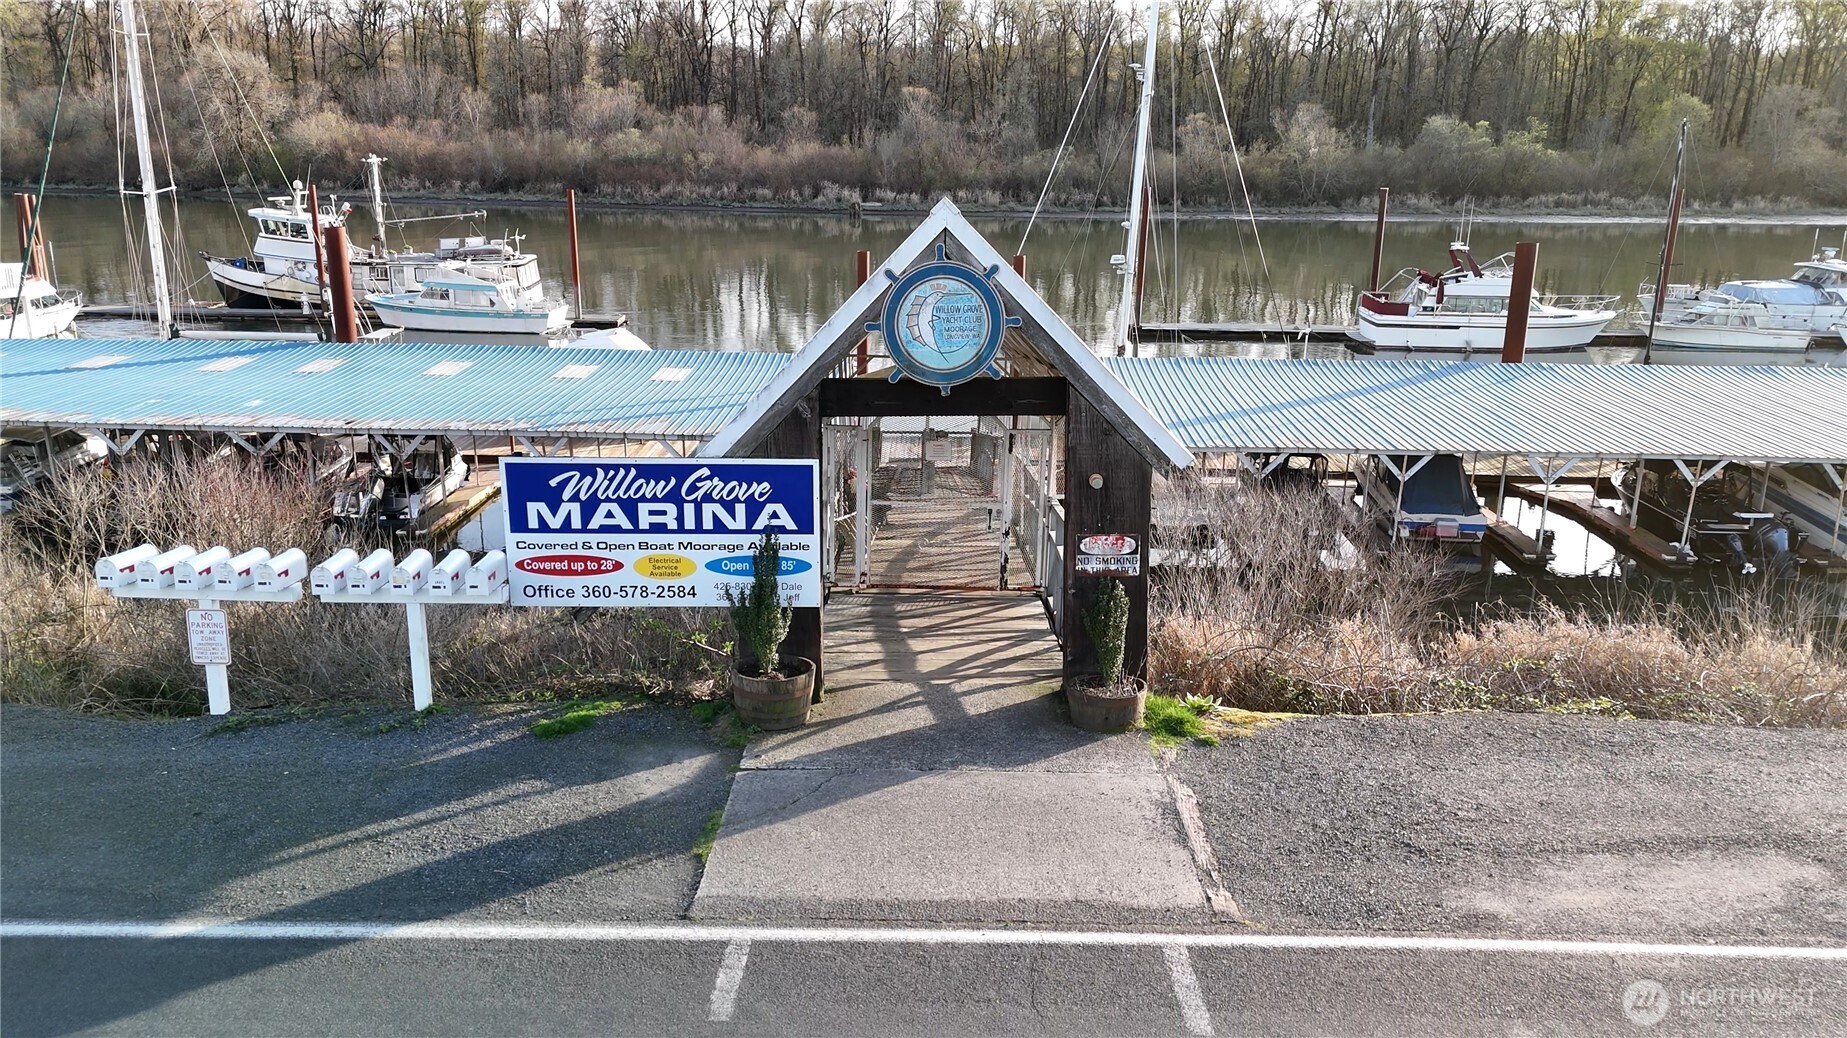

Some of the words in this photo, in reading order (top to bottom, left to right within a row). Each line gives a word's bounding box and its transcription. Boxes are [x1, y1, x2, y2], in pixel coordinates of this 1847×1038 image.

[935, 304, 961, 314] WILLOW
[963, 304, 983, 314] GROVE
[942, 316, 962, 324] YACHT
[964, 316, 982, 324] CLUB
[549, 467, 676, 502] Willow
[681, 467, 773, 502] Grove
[526, 502, 799, 531] MARINA
[515, 541, 578, 551] Covered
[581, 541, 594, 550] &
[596, 541, 636, 553] Open
[638, 541, 675, 551] Boat
[678, 541, 744, 553] Moorage
[747, 541, 810, 551] Avlable
[523, 559, 568, 570] Covered
[571, 561, 584, 573] up
[587, 559, 598, 570] to
[600, 559, 616, 571] 28'
[1077, 557, 1090, 565] NO
[1095, 556, 1138, 565] SMOKING
[721, 560, 750, 573] Open
[781, 560, 796, 571] 85'
[522, 584, 576, 599] Office
[581, 584, 697, 599] 360-578-2584
[781, 582, 803, 591] Dale
[783, 593, 800, 602] Jeff
[201, 613, 213, 621] NO
